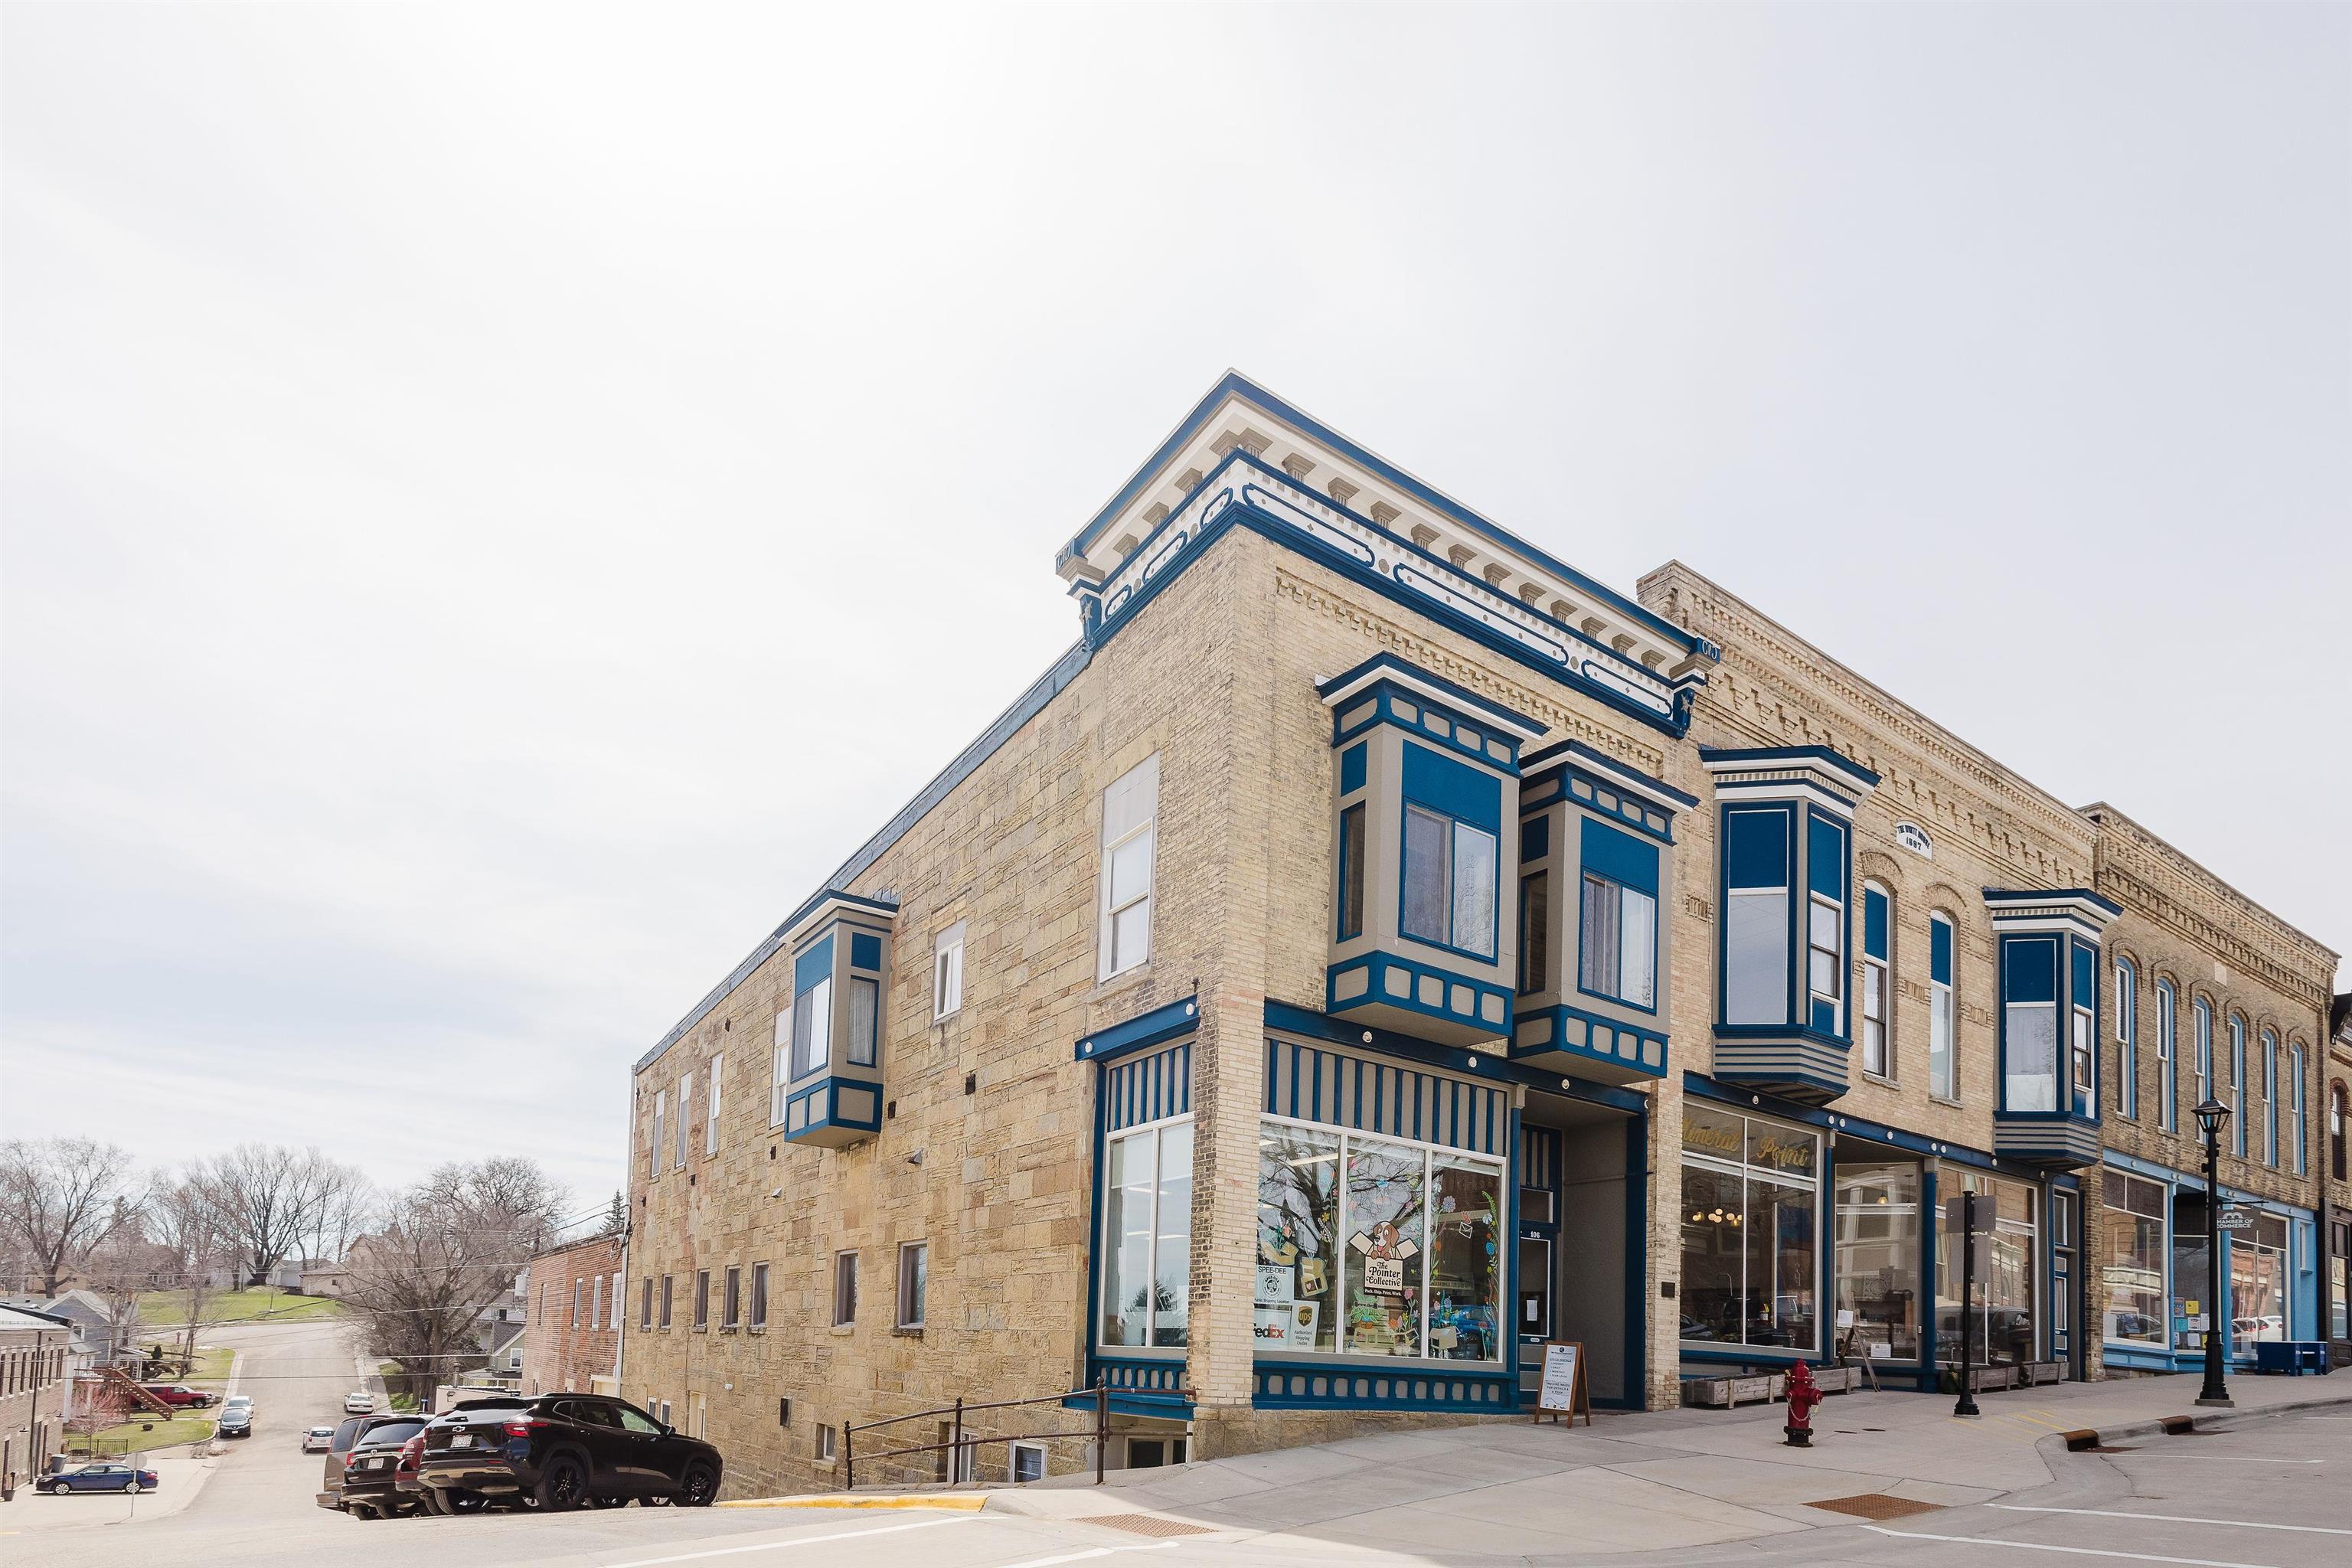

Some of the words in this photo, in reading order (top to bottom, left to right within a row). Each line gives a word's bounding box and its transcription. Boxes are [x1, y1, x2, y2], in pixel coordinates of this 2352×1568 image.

[1757, 1136, 1808, 1166] Point
[1258, 1266, 1287, 1275] SPEE-DEE
[1377, 1261, 1388, 1269] The
[1368, 1266, 1400, 1278] Pointer
[1365, 1276, 1402, 1287] Collective
[1298, 1312, 1312, 1324] ups
